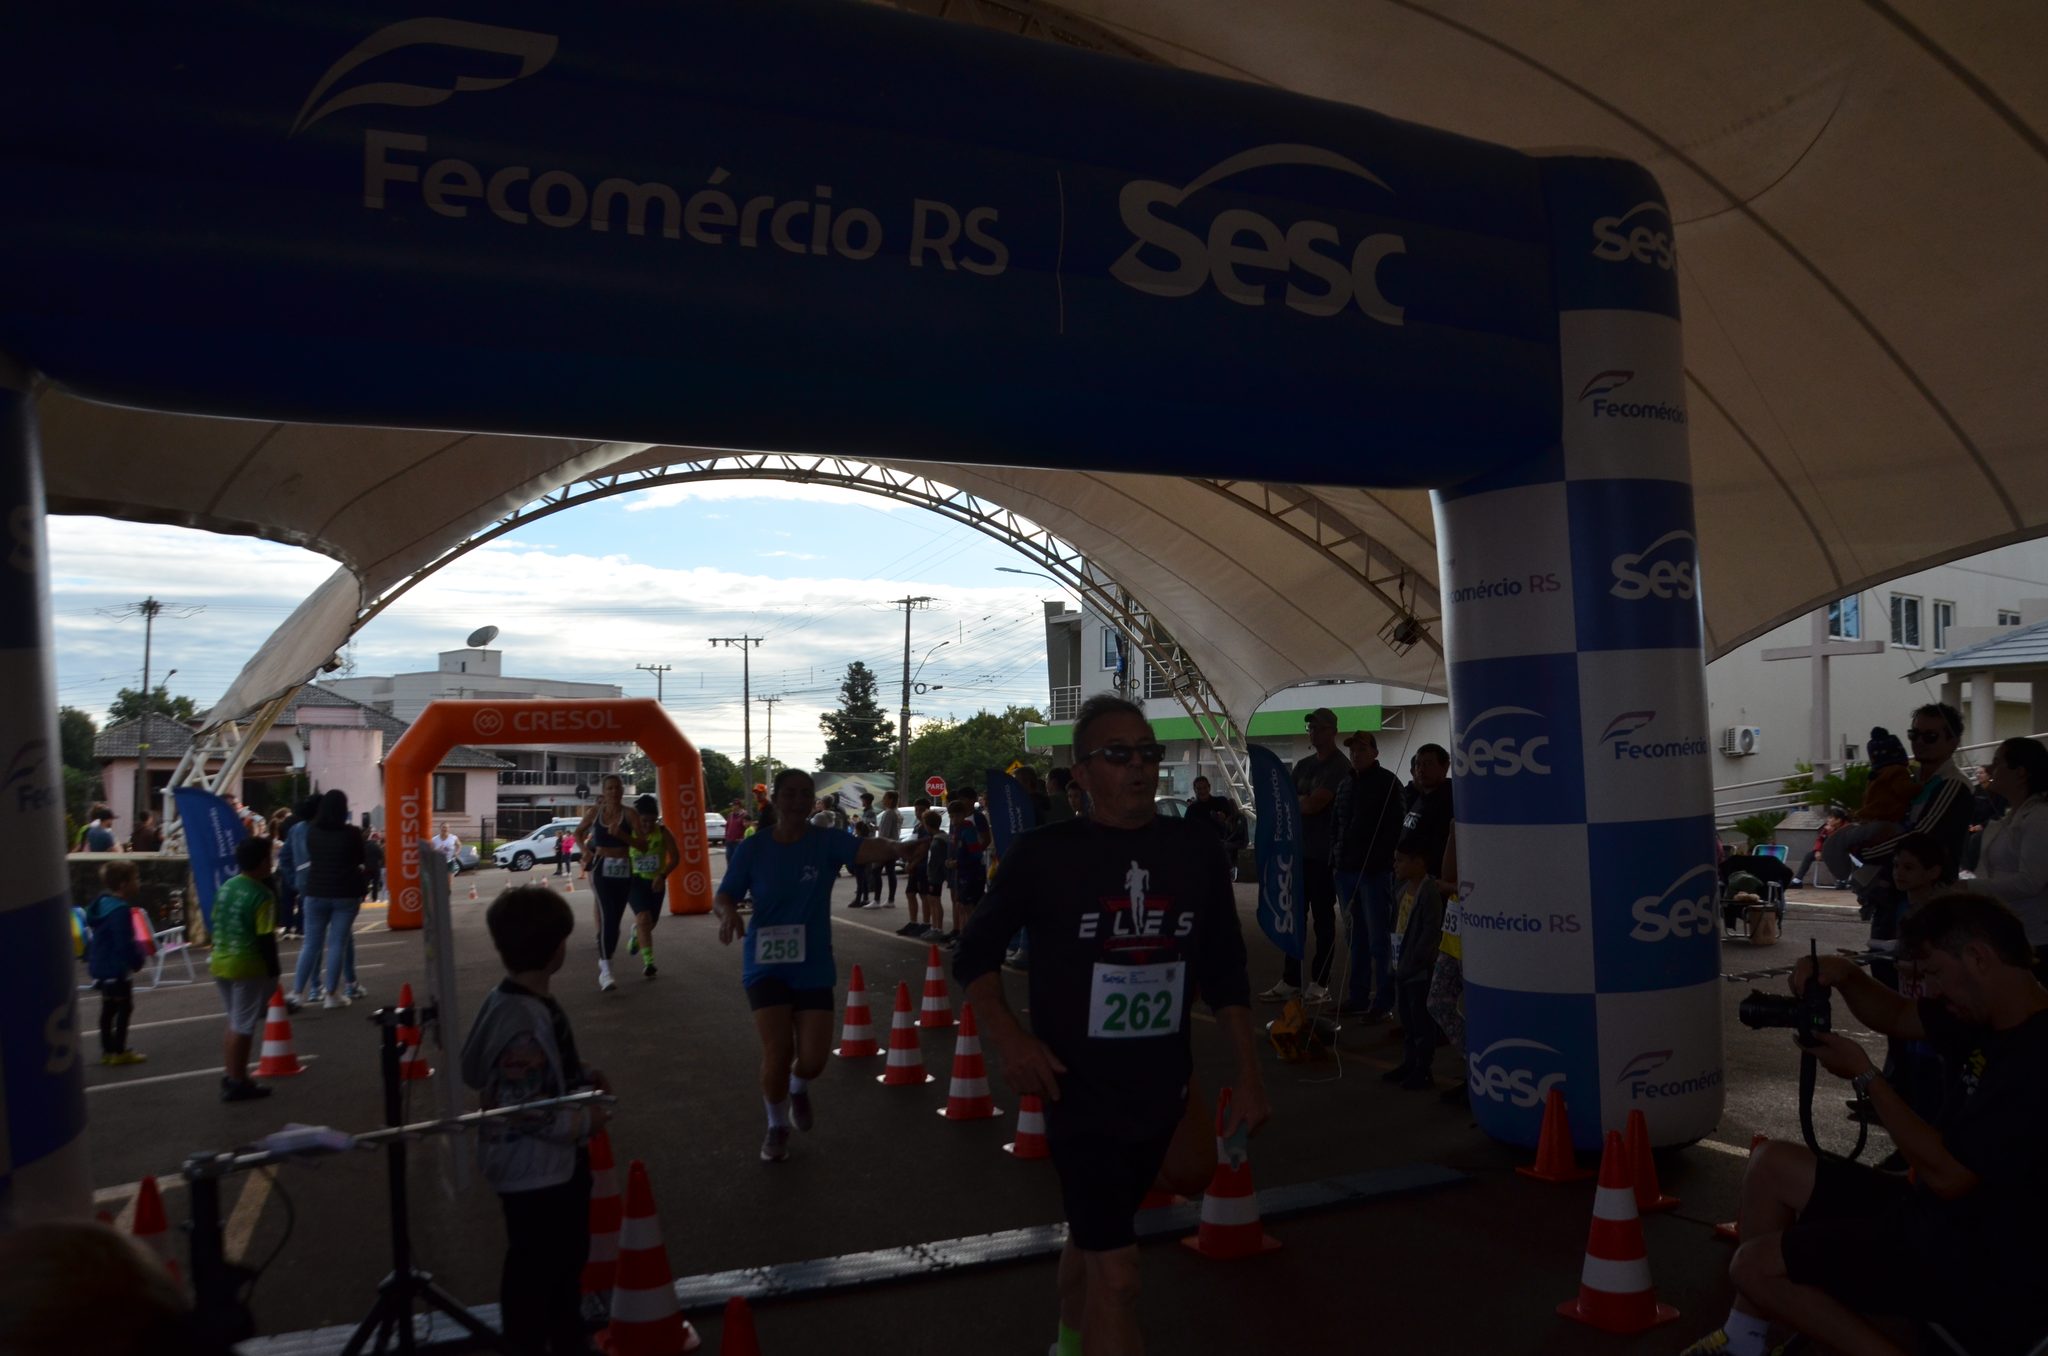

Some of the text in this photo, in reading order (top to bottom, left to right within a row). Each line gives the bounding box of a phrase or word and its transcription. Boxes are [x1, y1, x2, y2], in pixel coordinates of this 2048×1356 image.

[362, 129, 1010, 277] Fecomércio RS
[1108, 178, 1408, 327] Sesc
[1592, 216, 1676, 272] Ses
[1529, 573, 1561, 593] RS
[1609, 552, 1696, 601] Ses
[512, 708, 622, 733] CRESOL
[400, 786, 421, 881] CRESOL
[680, 776, 700, 865] CRESOL
[1549, 914, 1582, 933] RS
[1629, 895, 1715, 942] Ses
[761, 938, 799, 961] 258
[1102, 990, 1172, 1031] 262
